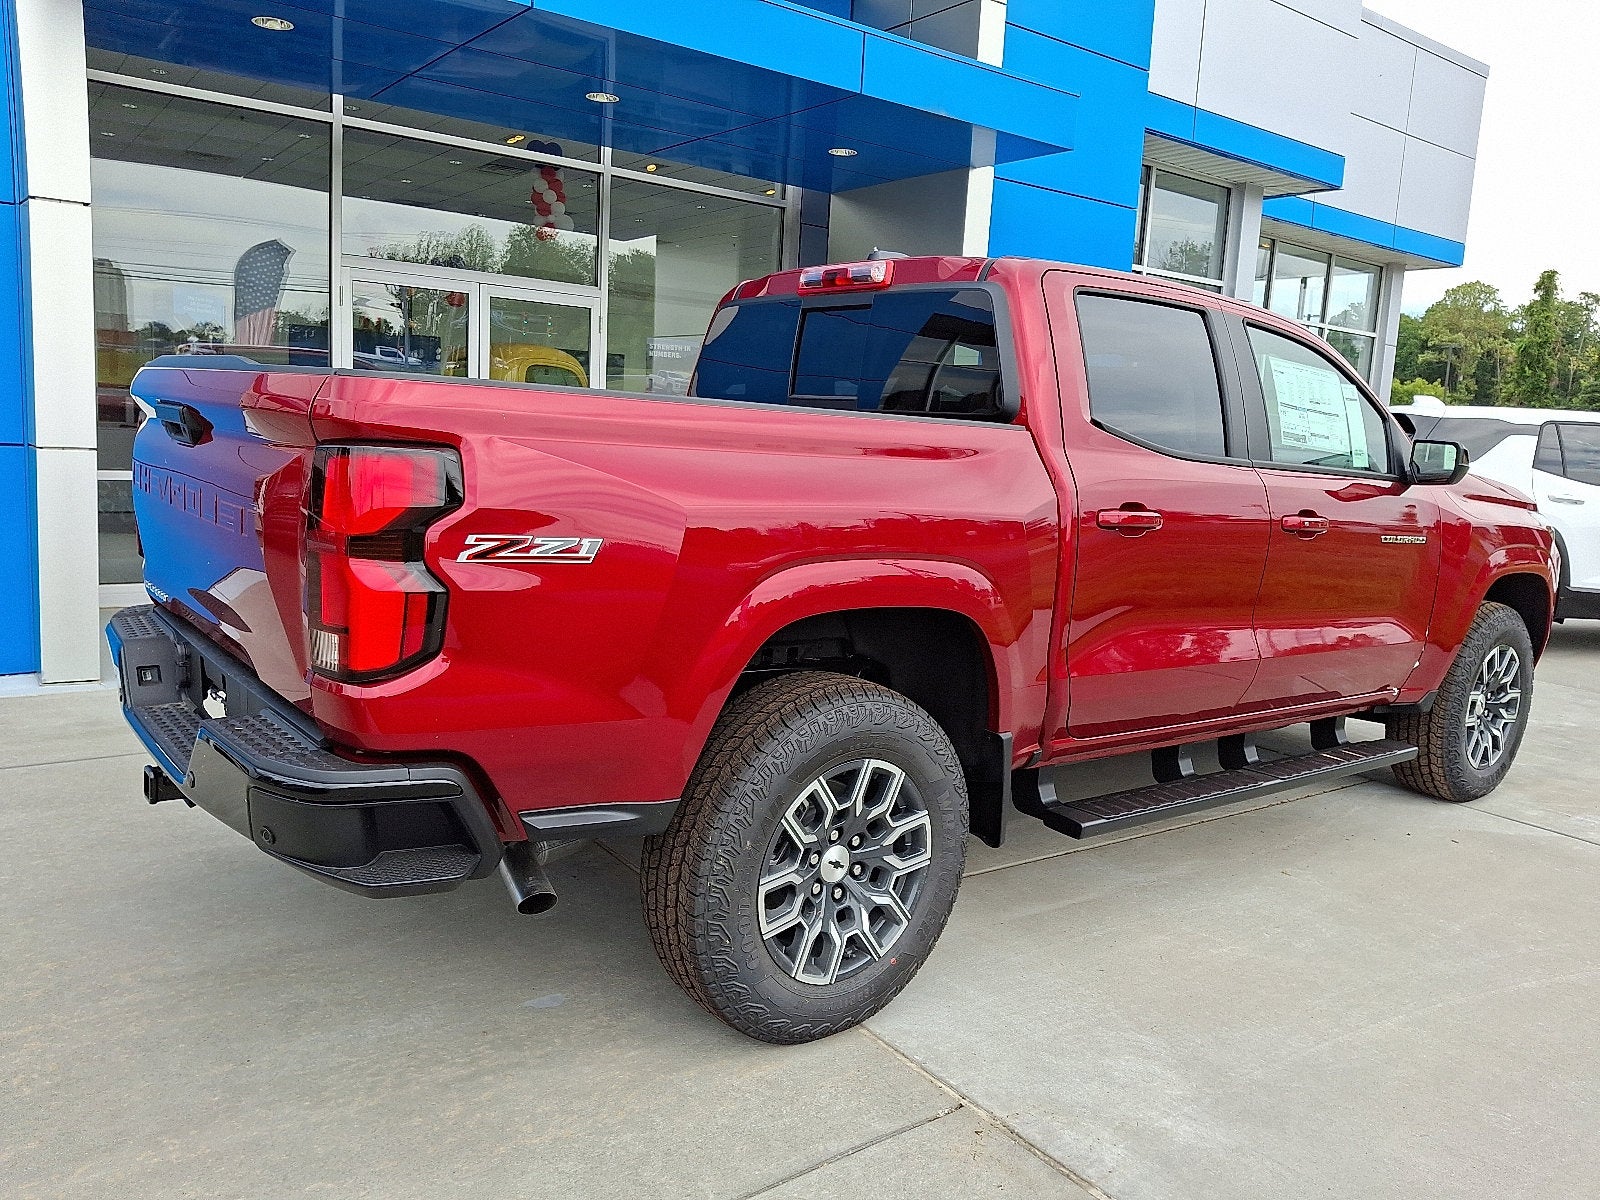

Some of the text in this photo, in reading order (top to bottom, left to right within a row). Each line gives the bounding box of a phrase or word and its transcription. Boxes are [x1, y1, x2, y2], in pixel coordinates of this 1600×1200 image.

[649, 343, 683, 351] STRENGTH
[649, 350, 682, 359] NUMBERS.
[132, 461, 249, 537] CHEVROLET
[455, 533, 604, 564] Z71
